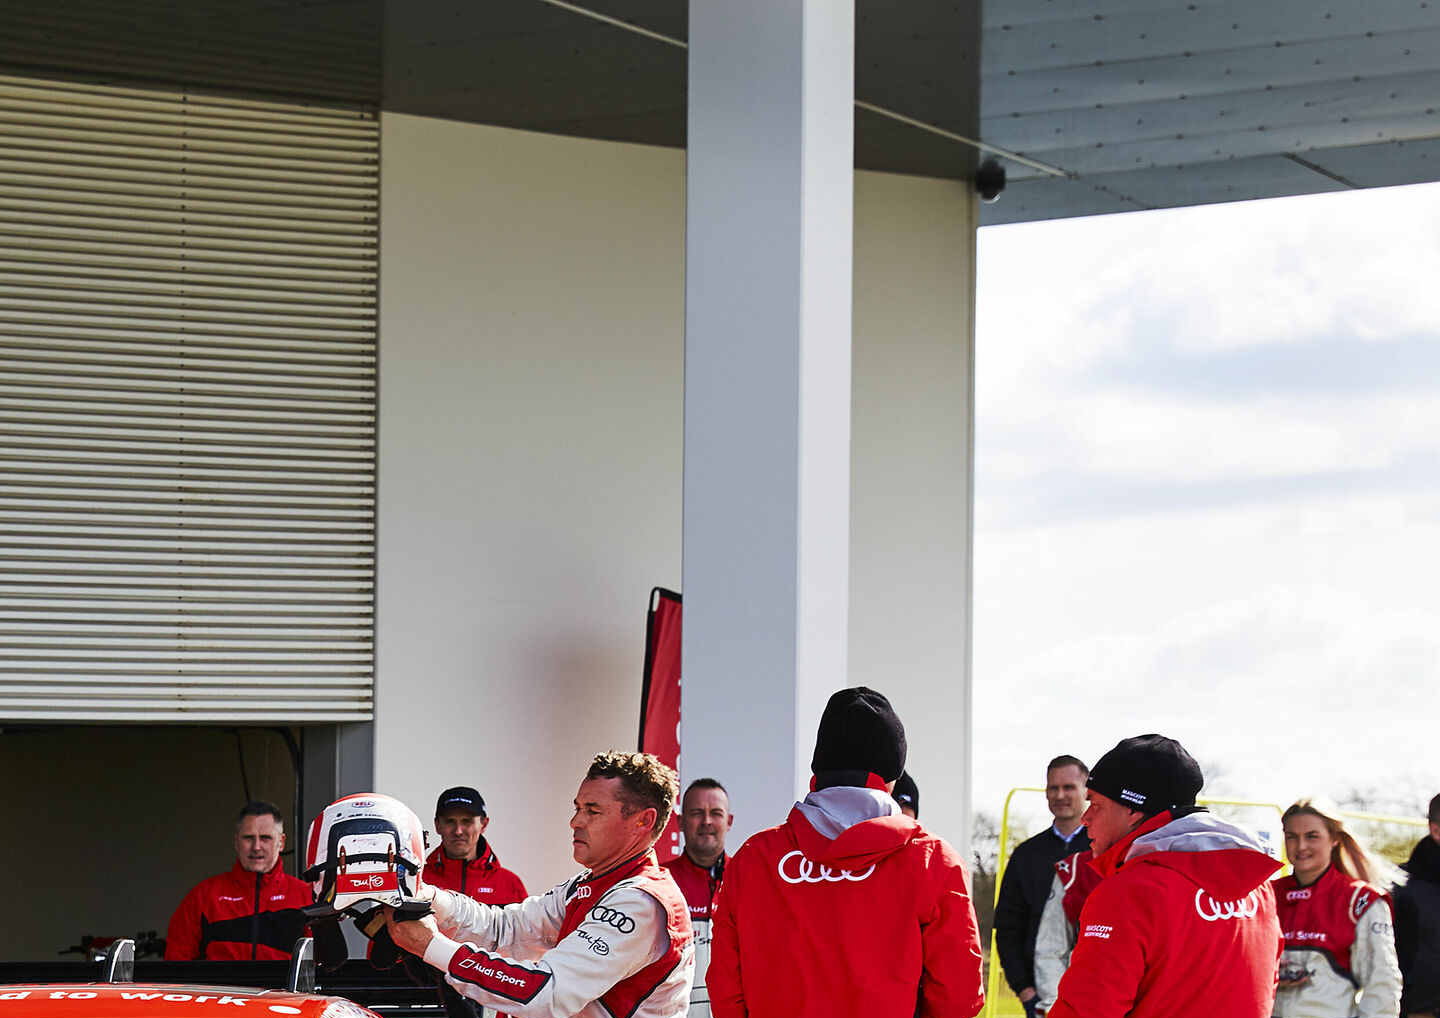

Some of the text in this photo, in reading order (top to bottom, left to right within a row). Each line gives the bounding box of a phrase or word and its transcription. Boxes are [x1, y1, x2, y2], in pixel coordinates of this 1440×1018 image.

[472, 962, 527, 988] Audi Sport
[48, 990, 98, 1000] to
[120, 991, 251, 1007] work
